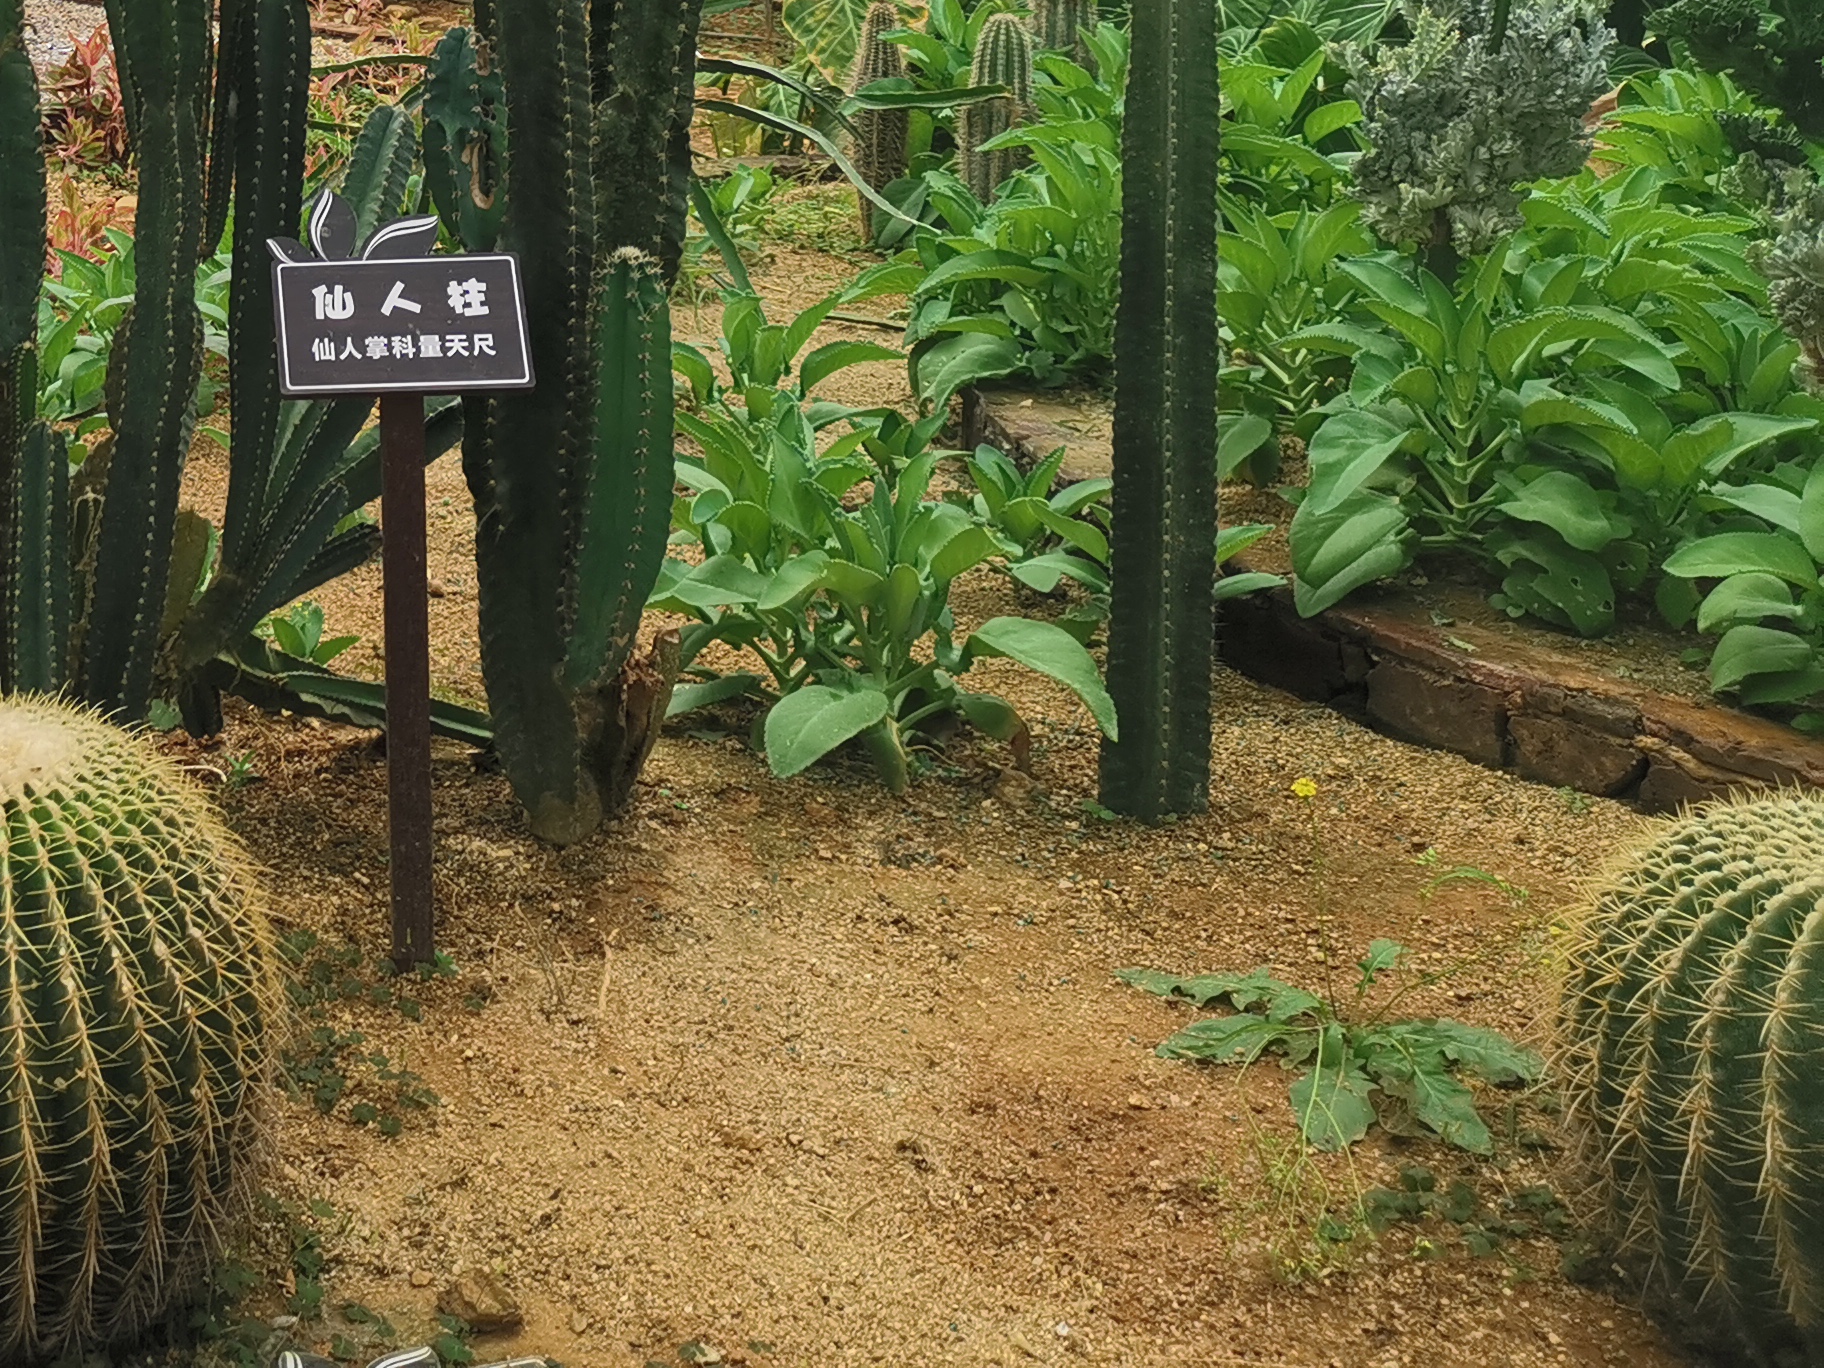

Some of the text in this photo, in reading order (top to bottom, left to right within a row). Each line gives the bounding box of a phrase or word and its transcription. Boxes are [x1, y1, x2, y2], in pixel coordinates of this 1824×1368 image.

[311, 278, 490, 320] 仙人柱
[311, 333, 496, 362] 仙人掌科量天尺
